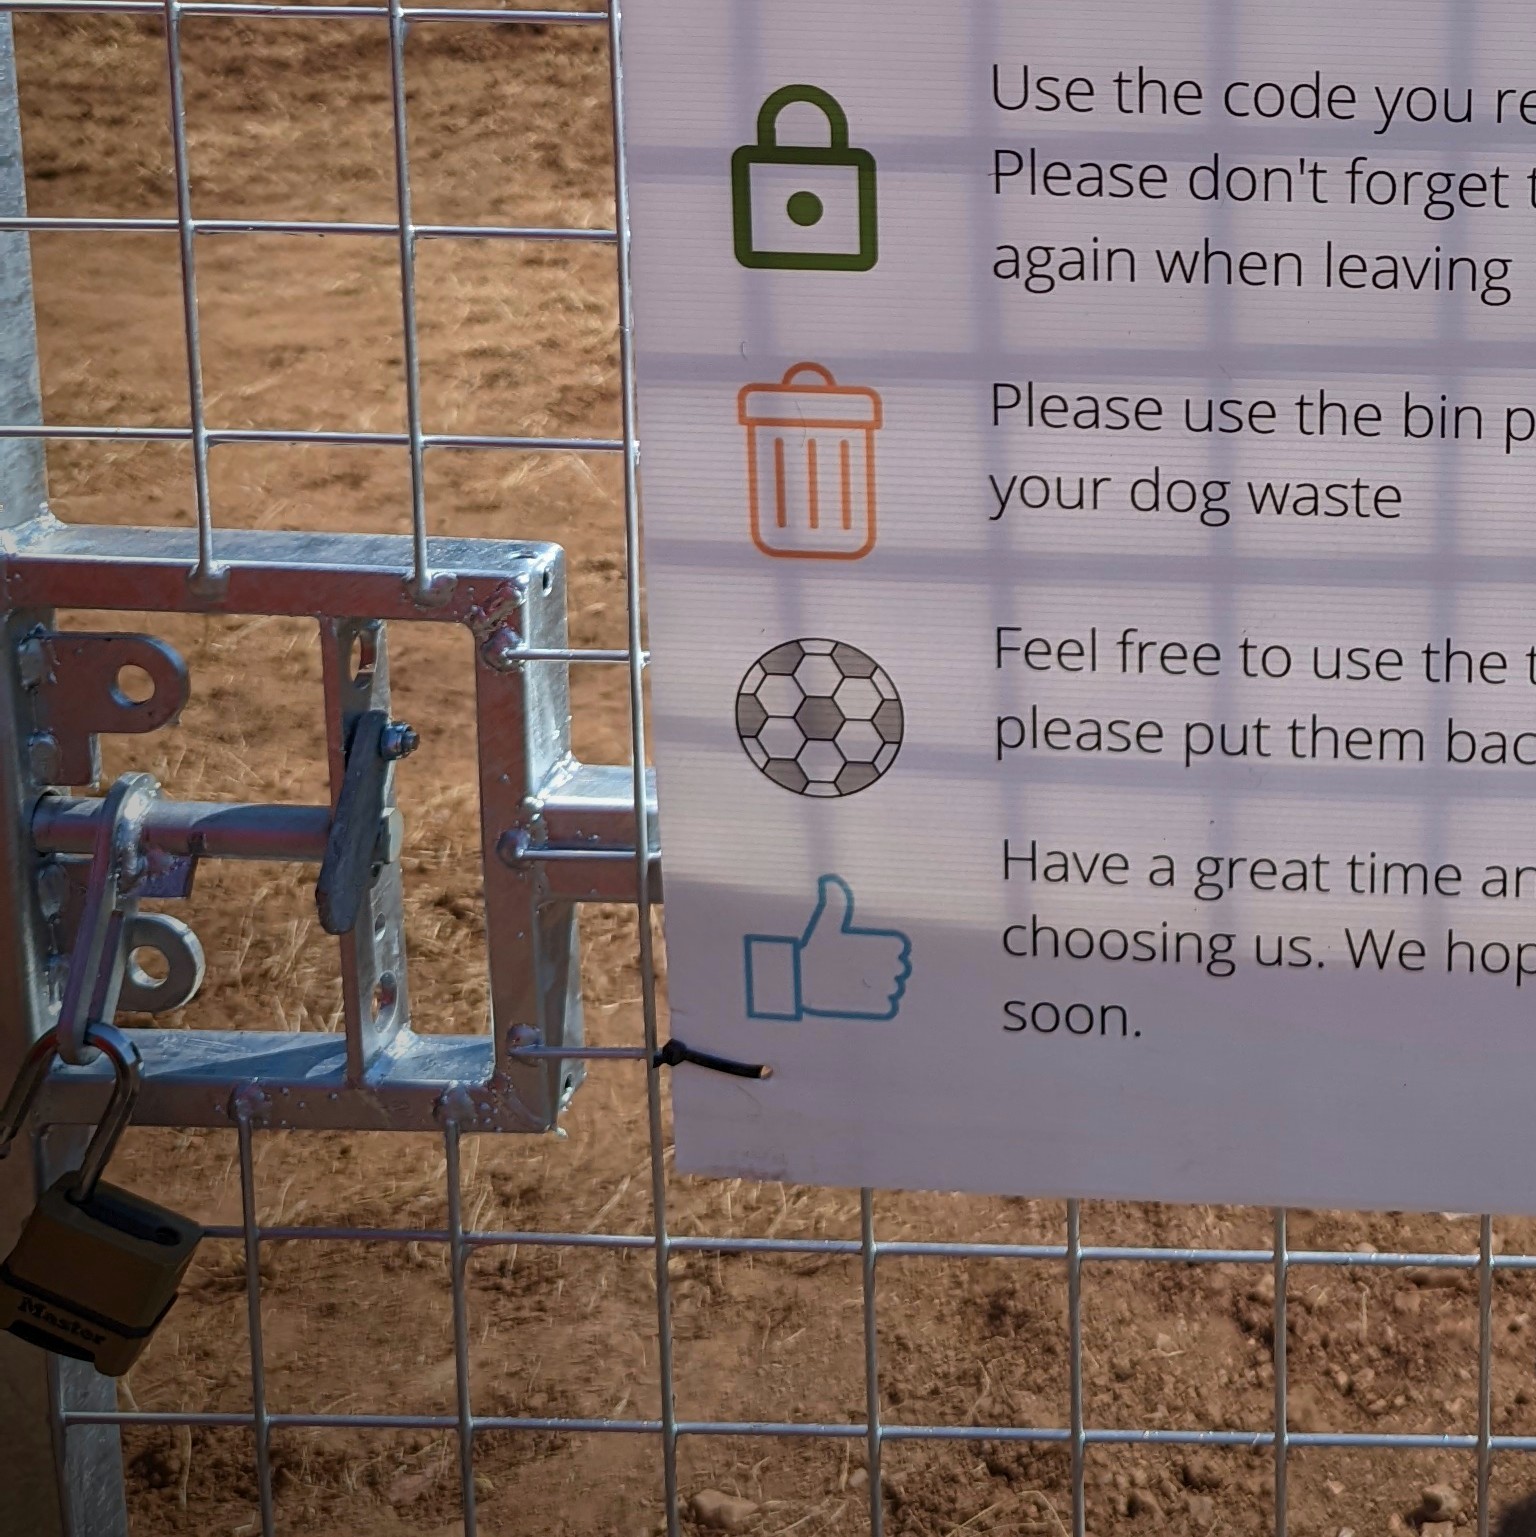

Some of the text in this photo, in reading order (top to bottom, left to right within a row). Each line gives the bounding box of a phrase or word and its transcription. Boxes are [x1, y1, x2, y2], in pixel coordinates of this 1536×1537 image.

[991, 62, 1096, 114] Use
[1111, 64, 1204, 117] the
[1222, 69, 1358, 122] code
[1372, 85, 1474, 136] you
[991, 146, 1169, 201] Please
[1187, 151, 1330, 205] don't
[1343, 155, 1511, 222] forget
[991, 235, 1514, 308] again when leaving
[991, 379, 1164, 433] Please
[1183, 397, 1278, 436] use
[1293, 387, 1383, 439] the
[1402, 389, 1484, 441] bin
[986, 464, 1403, 529] your dog waste
[994, 625, 1098, 673] Feel
[1114, 626, 1223, 678] free
[1237, 636, 1293, 680] to
[1312, 645, 1405, 683] use
[1419, 636, 1509, 686] the
[994, 703, 1165, 764] please
[1183, 716, 1273, 770] put
[1286, 712, 1425, 763] them
[1002, 837, 1131, 887] Have
[1147, 853, 1176, 888] a
[1192, 852, 1332, 903] great
[1345, 850, 1463, 898] time
[1001, 912, 1238, 979] choosing
[1254, 933, 1326, 970] us.
[1343, 926, 1427, 973] We
[1001, 999, 1143, 1039] soon.
[17, 1295, 106, 1345] Master
